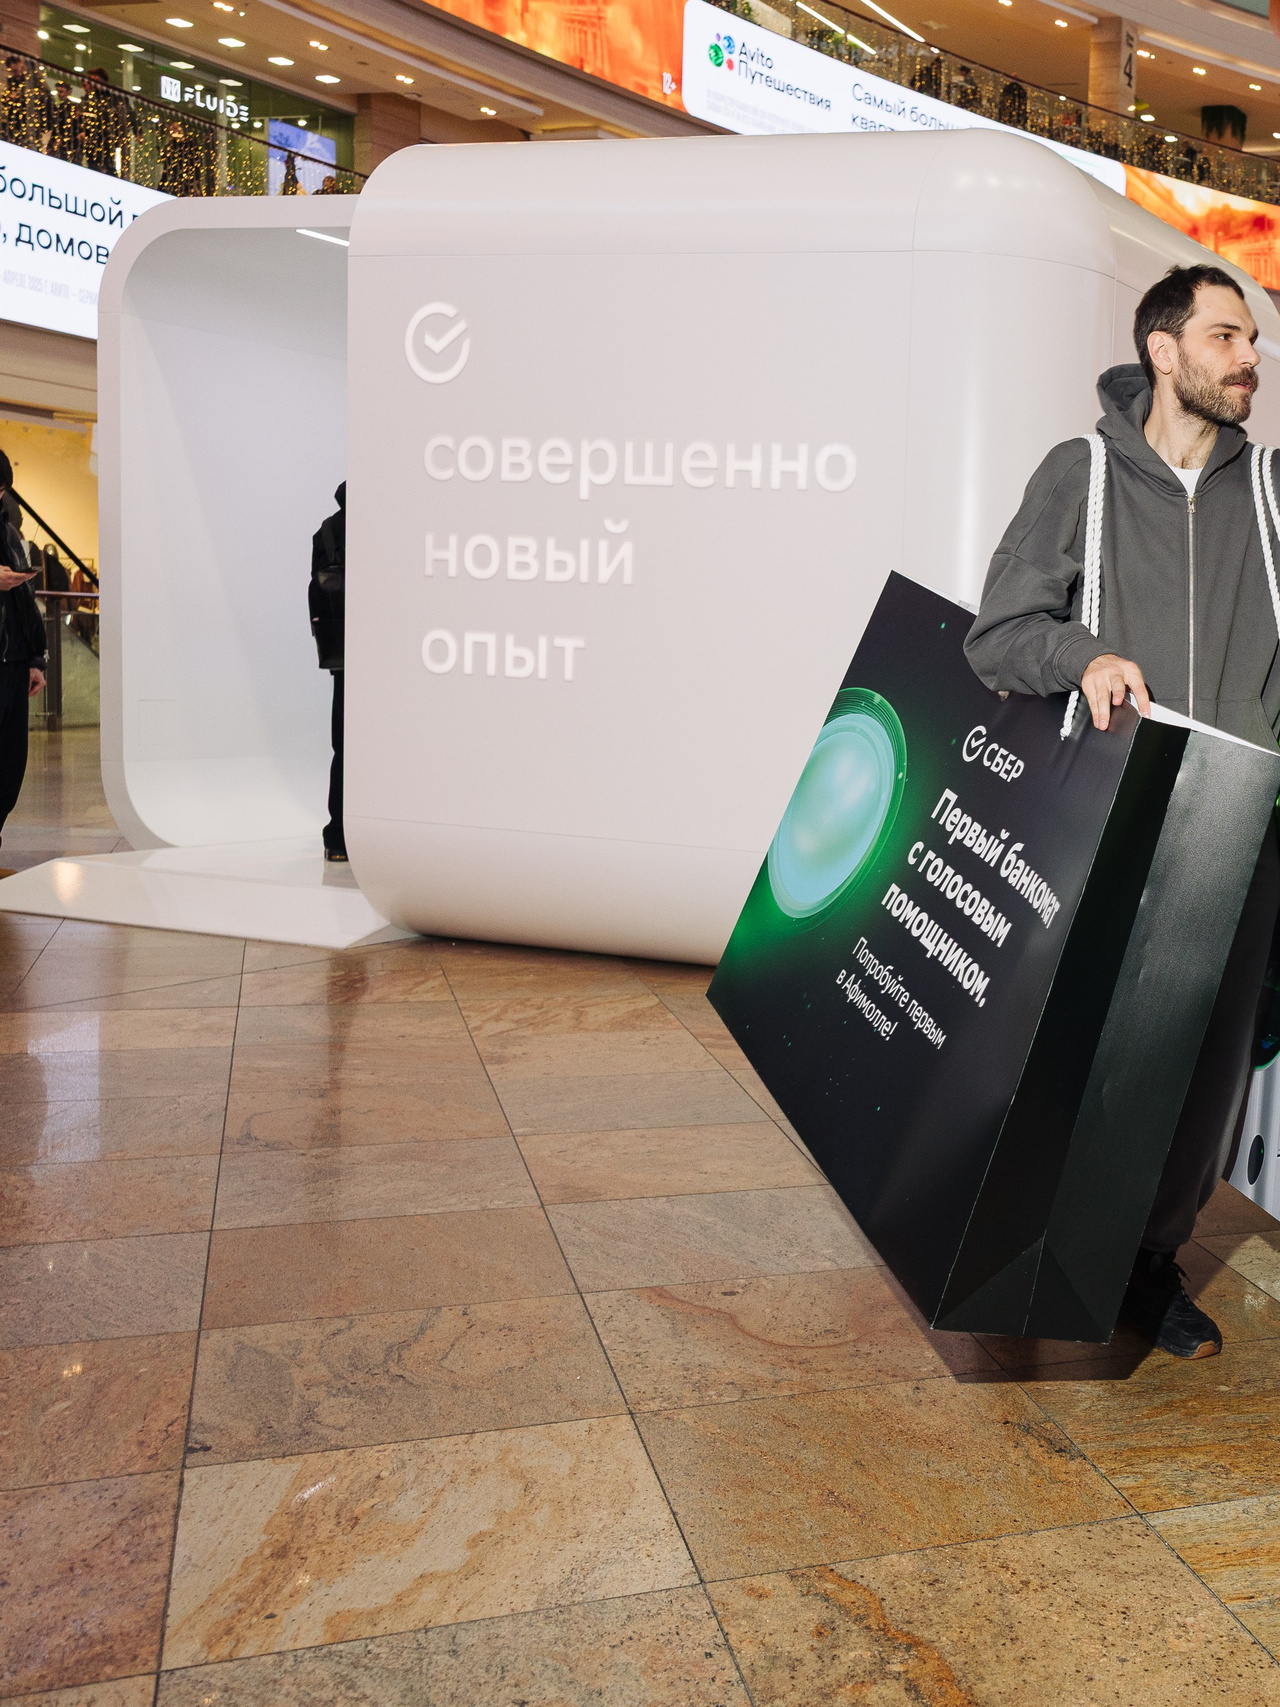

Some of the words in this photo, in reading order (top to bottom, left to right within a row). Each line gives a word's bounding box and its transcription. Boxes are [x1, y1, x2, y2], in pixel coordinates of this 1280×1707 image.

[738, 60, 832, 111] Путешествия
[739, 42, 774, 69] Avito
[184, 87, 249, 122] FLUIDE
[852, 83, 906, 118] Самый
[423, 434, 857, 501] совершенно
[423, 518, 634, 586] новый
[421, 628, 585, 681] опыт
[983, 742, 1024, 783] СБЕР
[931, 788, 1011, 868] Первый
[1000, 842, 1061, 928] банкомат
[907, 841, 925, 865] с
[917, 849, 1013, 948] голосовым
[881, 883, 991, 1008] помощником.
[835, 969, 846, 985] в
[842, 972, 899, 1042] Афимолле!
[852, 936, 909, 1010] Попробуйте
[905, 998, 947, 1050] первым
